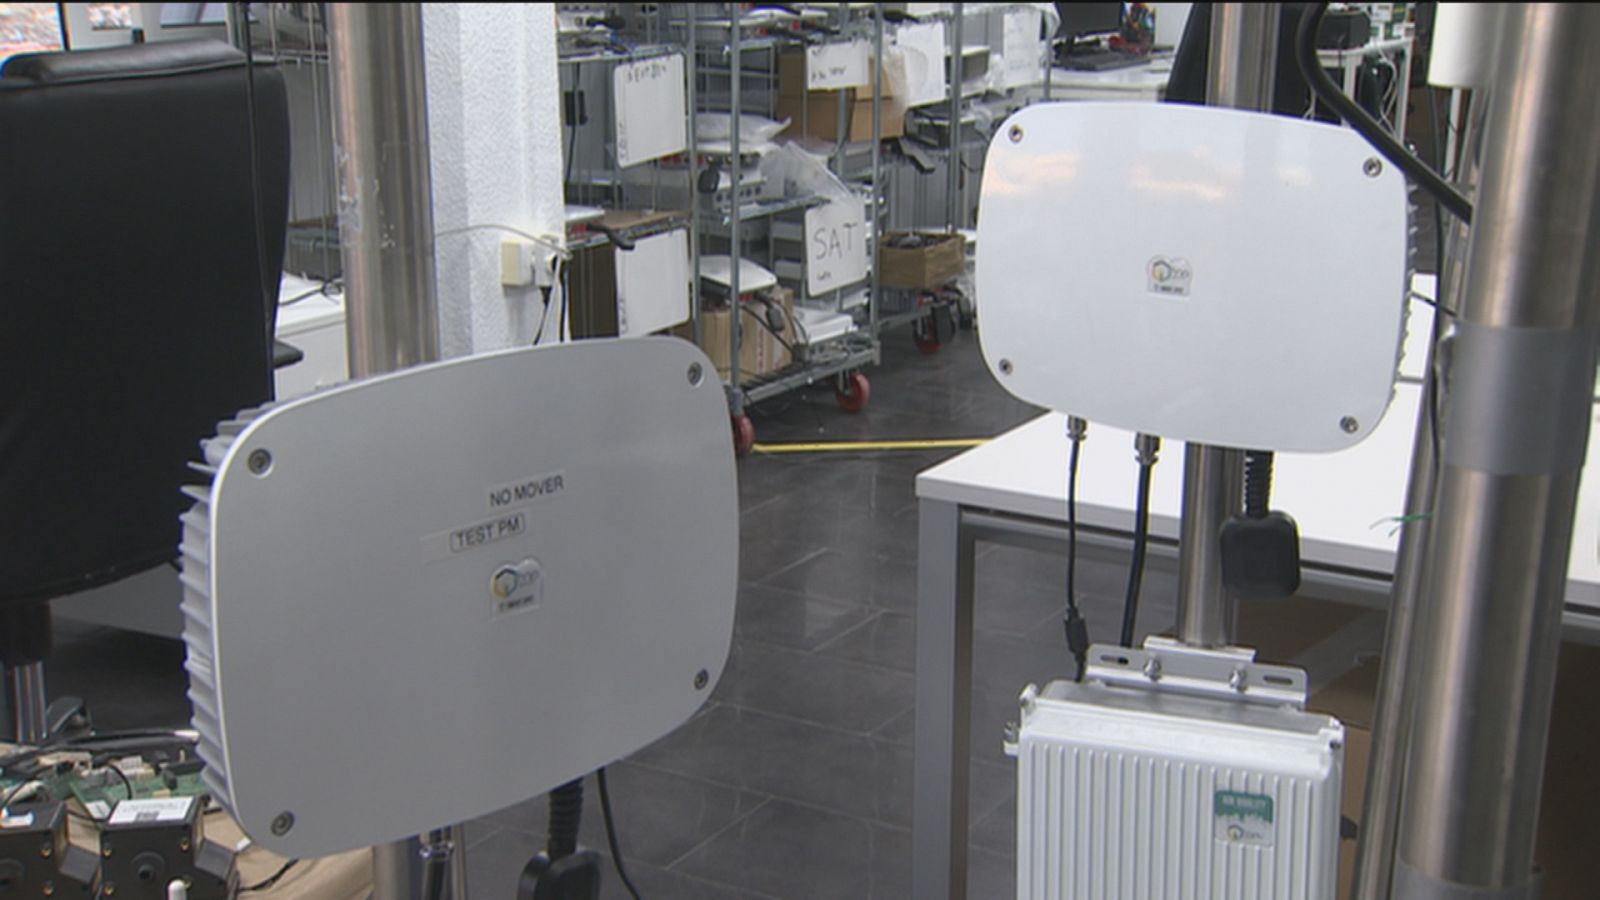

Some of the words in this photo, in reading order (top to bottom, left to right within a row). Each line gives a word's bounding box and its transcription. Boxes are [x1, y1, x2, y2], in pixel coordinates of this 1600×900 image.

[813, 222, 858, 260] SAT
[490, 489, 512, 507] NO
[514, 475, 565, 501] MOVER
[456, 523, 494, 548] TEST
[498, 516, 520, 536] PM
